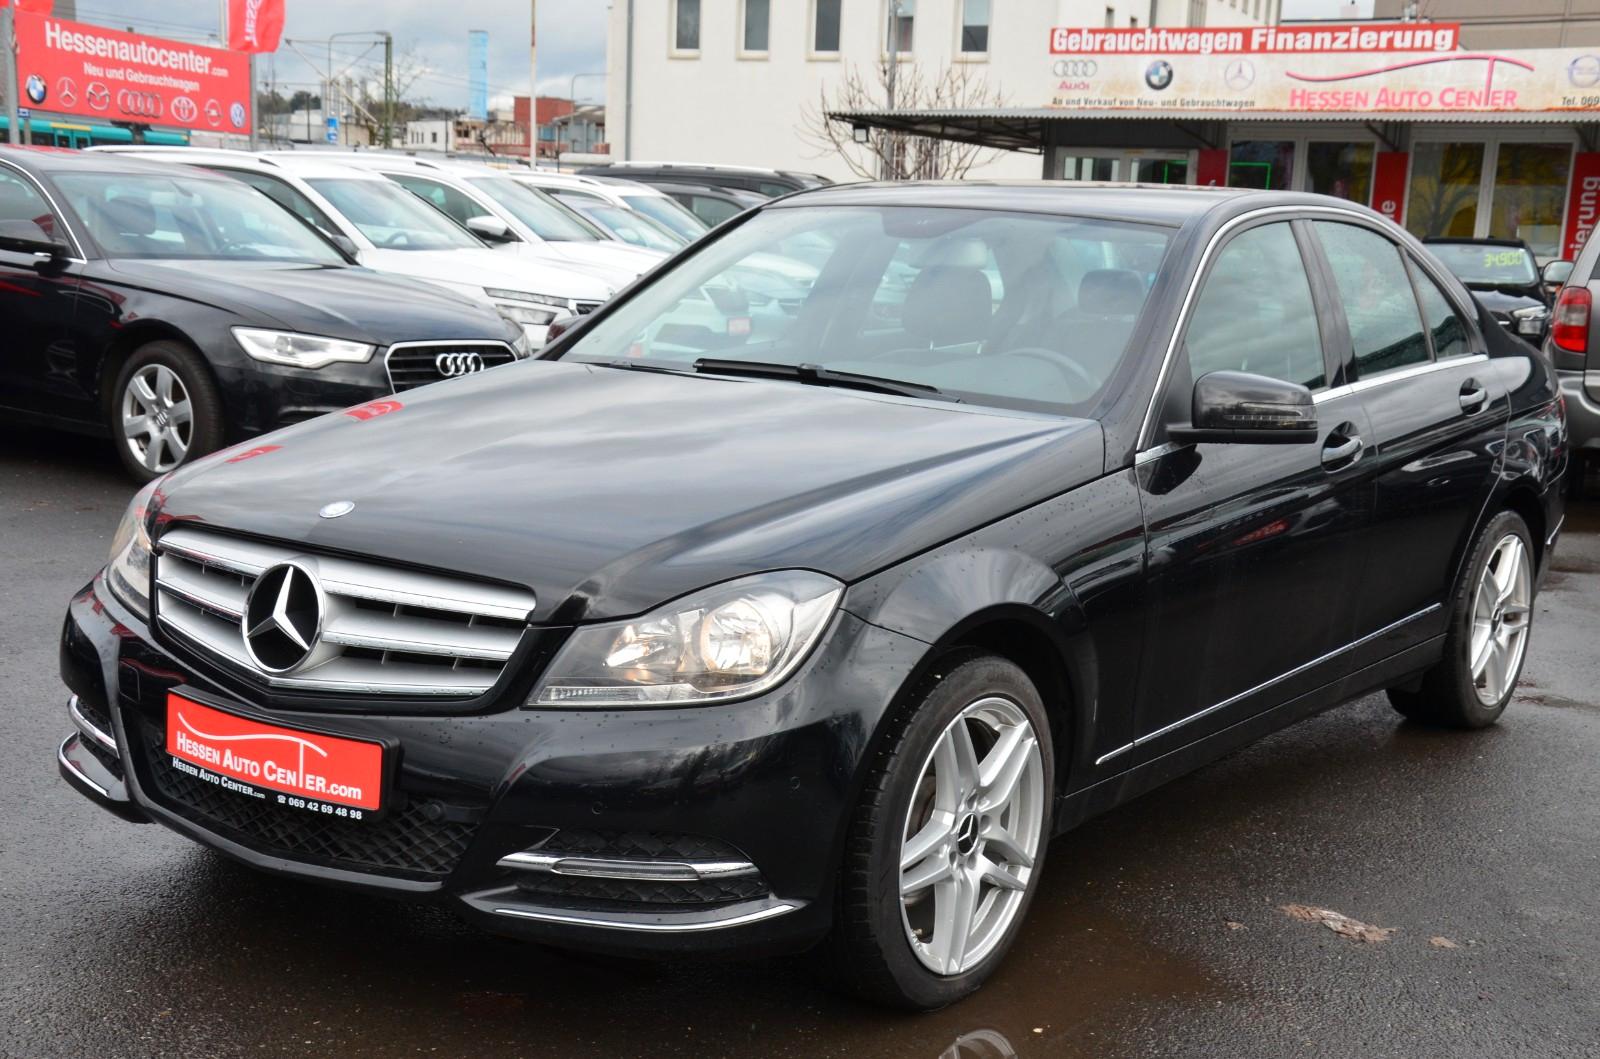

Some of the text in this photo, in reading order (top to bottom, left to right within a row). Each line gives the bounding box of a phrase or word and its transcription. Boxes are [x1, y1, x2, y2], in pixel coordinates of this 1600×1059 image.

[45, 21, 229, 78] Hessenautocenter.com
[1052, 27, 1455, 55] Gebrauchtwagen Finanzierung
[83, 62, 200, 93] Neu und Gebrauchtwagen
[1065, 97, 1081, 106] und
[1083, 97, 1117, 106] Verkauf
[1161, 98, 1178, 107] und
[1180, 98, 1256, 109] Gebrauchtwagen
[1290, 87, 1518, 107] HESSEN AUTO CENTER
[1561, 96, 1579, 106] Tel.
[176, 731, 220, 764] HESSEN
[222, 748, 260, 777] AUTO
[172, 757, 363, 820] HESSEN AUTO CENTER.com 069 42 69 48 98
